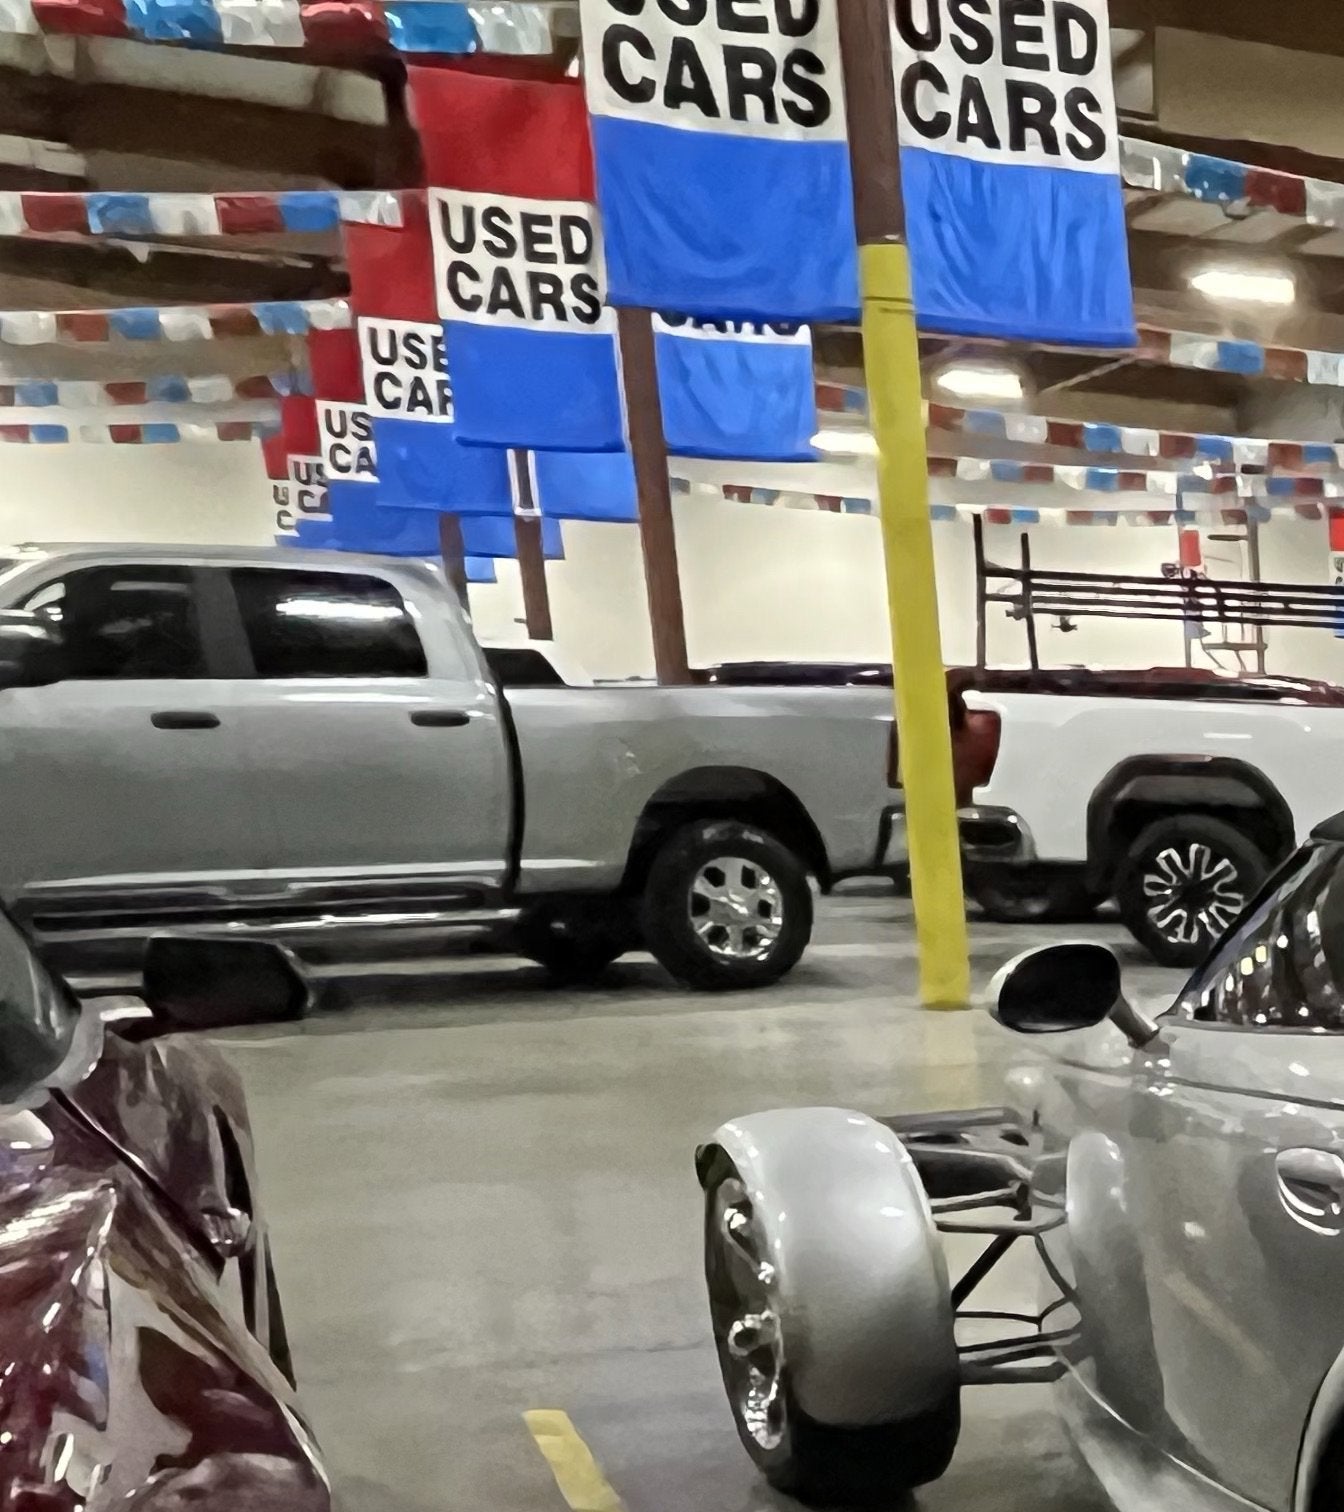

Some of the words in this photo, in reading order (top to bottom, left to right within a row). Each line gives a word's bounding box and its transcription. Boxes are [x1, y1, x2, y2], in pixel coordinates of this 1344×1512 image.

[895, 0, 1098, 76] USED
[602, 24, 831, 128] CARS
[901, 59, 1106, 161] CARS
[437, 199, 593, 265] USED
[446, 260, 601, 325] CARS
[370, 326, 449, 372] USE
[324, 408, 374, 441] US
[373, 371, 454, 416] CAR
[329, 442, 378, 475] CA
